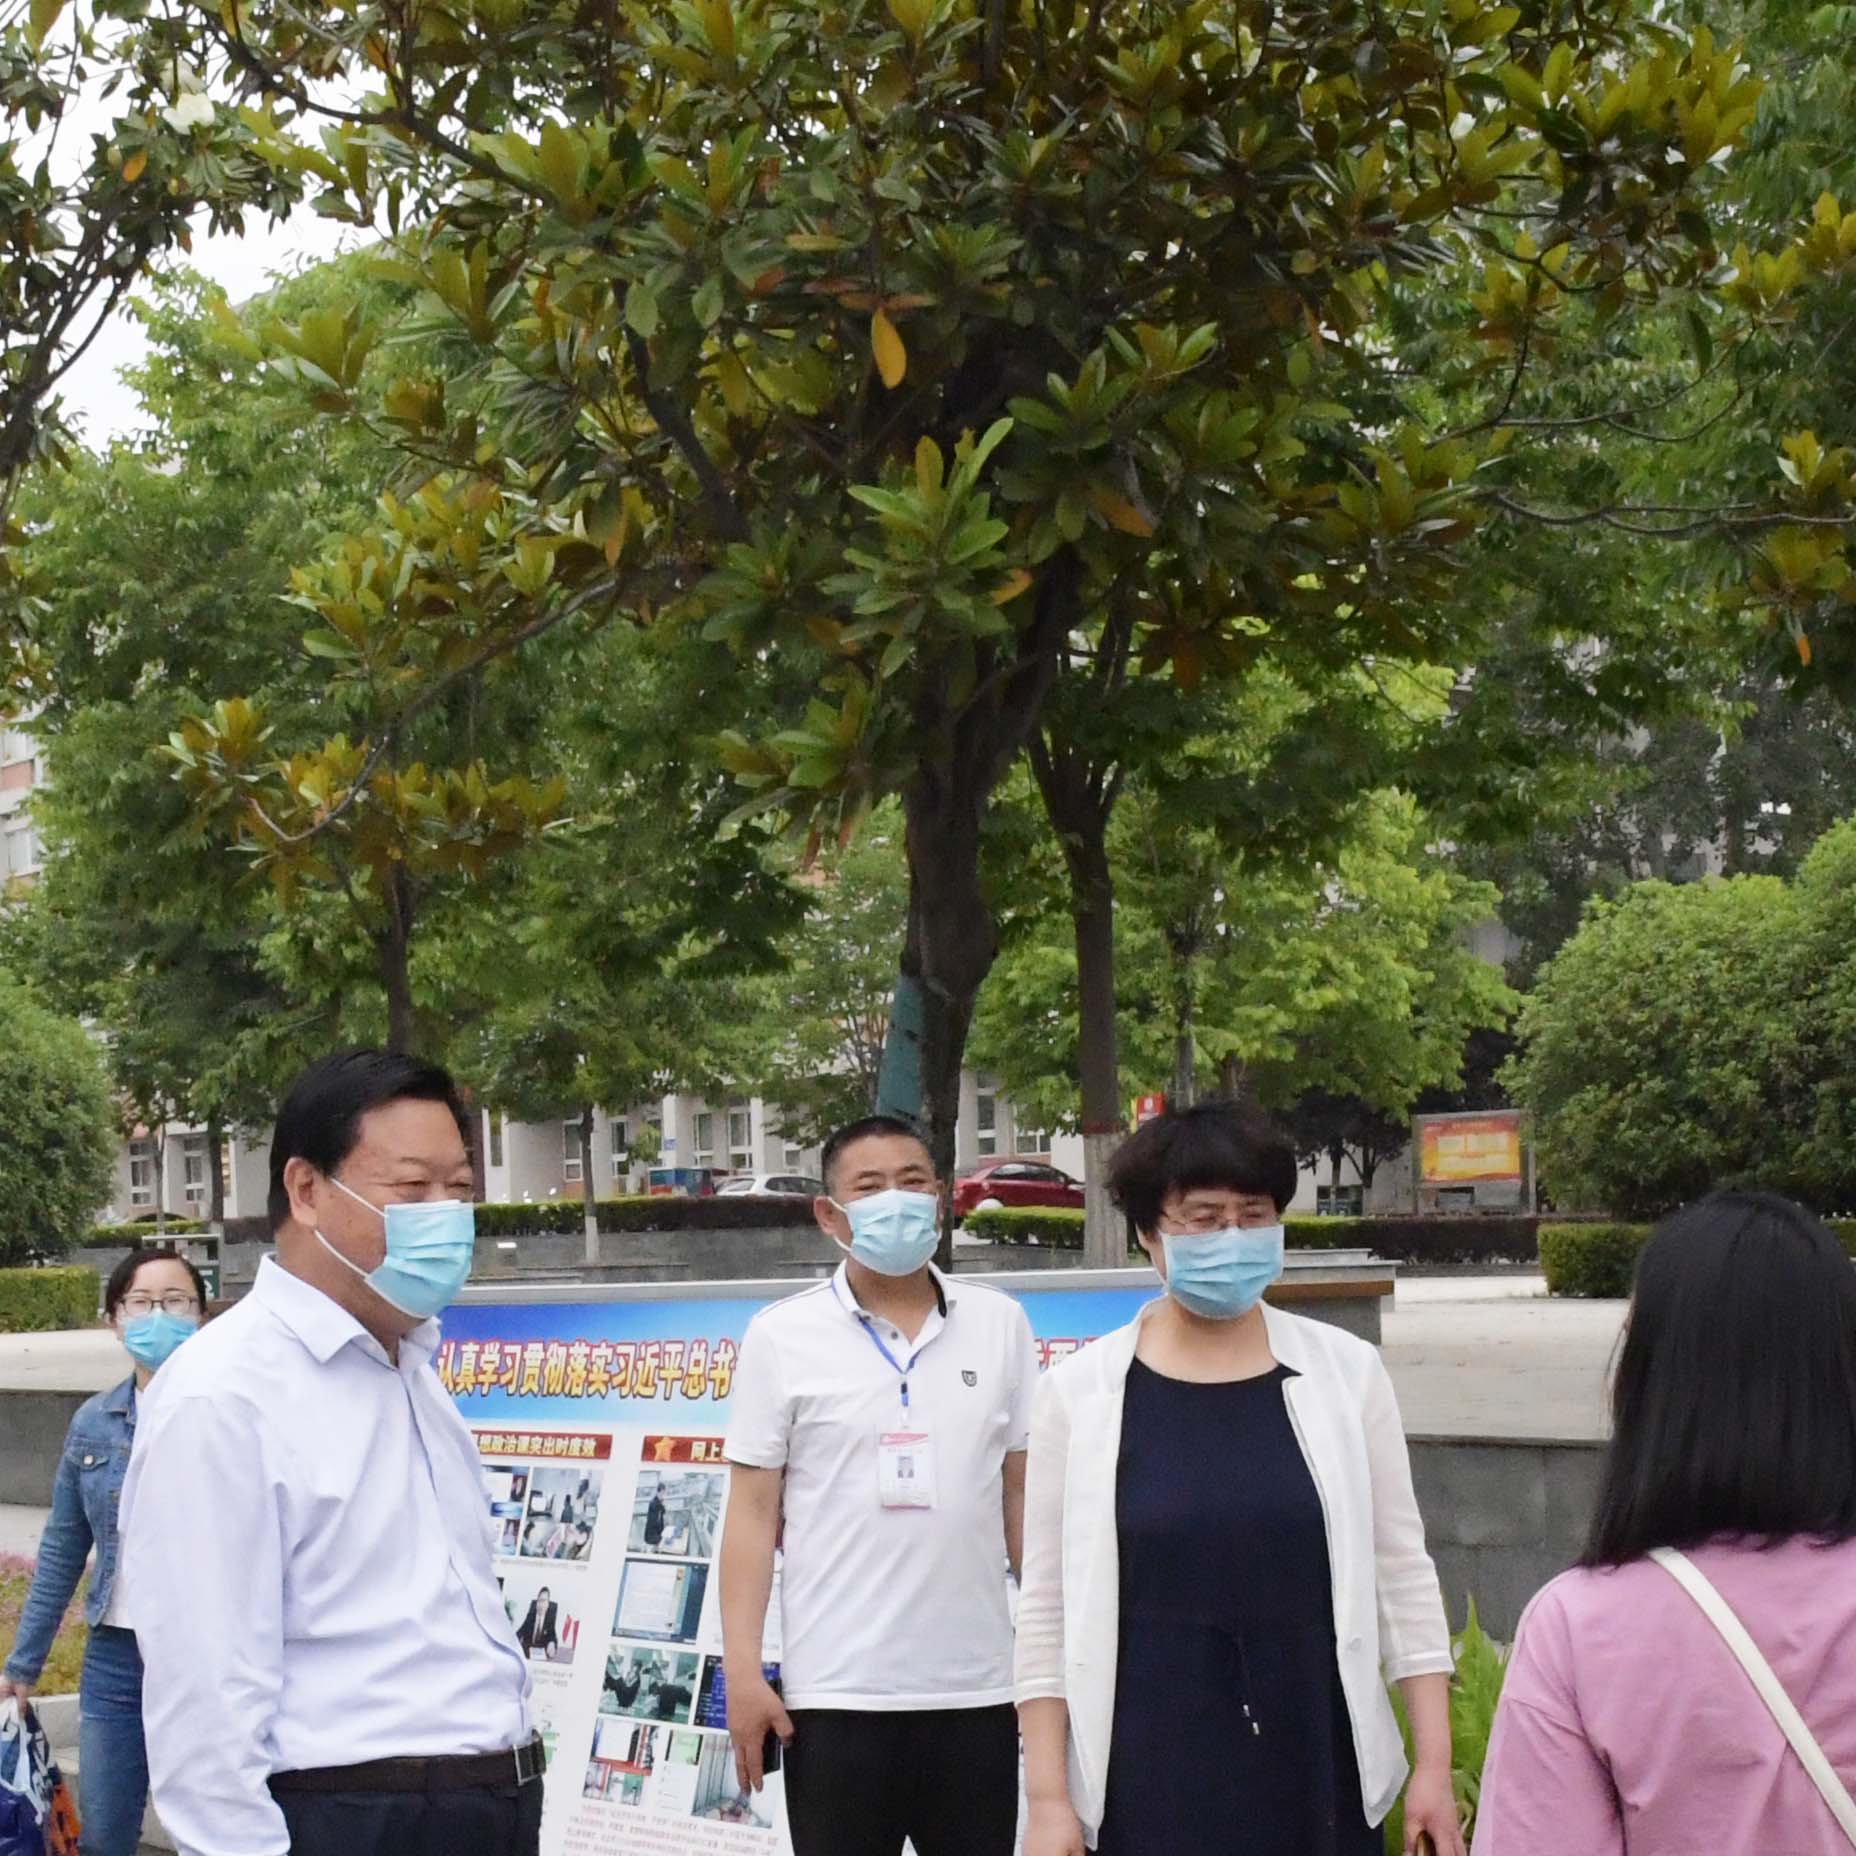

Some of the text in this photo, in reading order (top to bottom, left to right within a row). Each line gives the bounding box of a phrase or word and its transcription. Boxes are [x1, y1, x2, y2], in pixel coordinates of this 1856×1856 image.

[437, 1337, 736, 1401] 认真学习贯彻落实习近平总书
[690, 1440, 725, 1463] 网上
